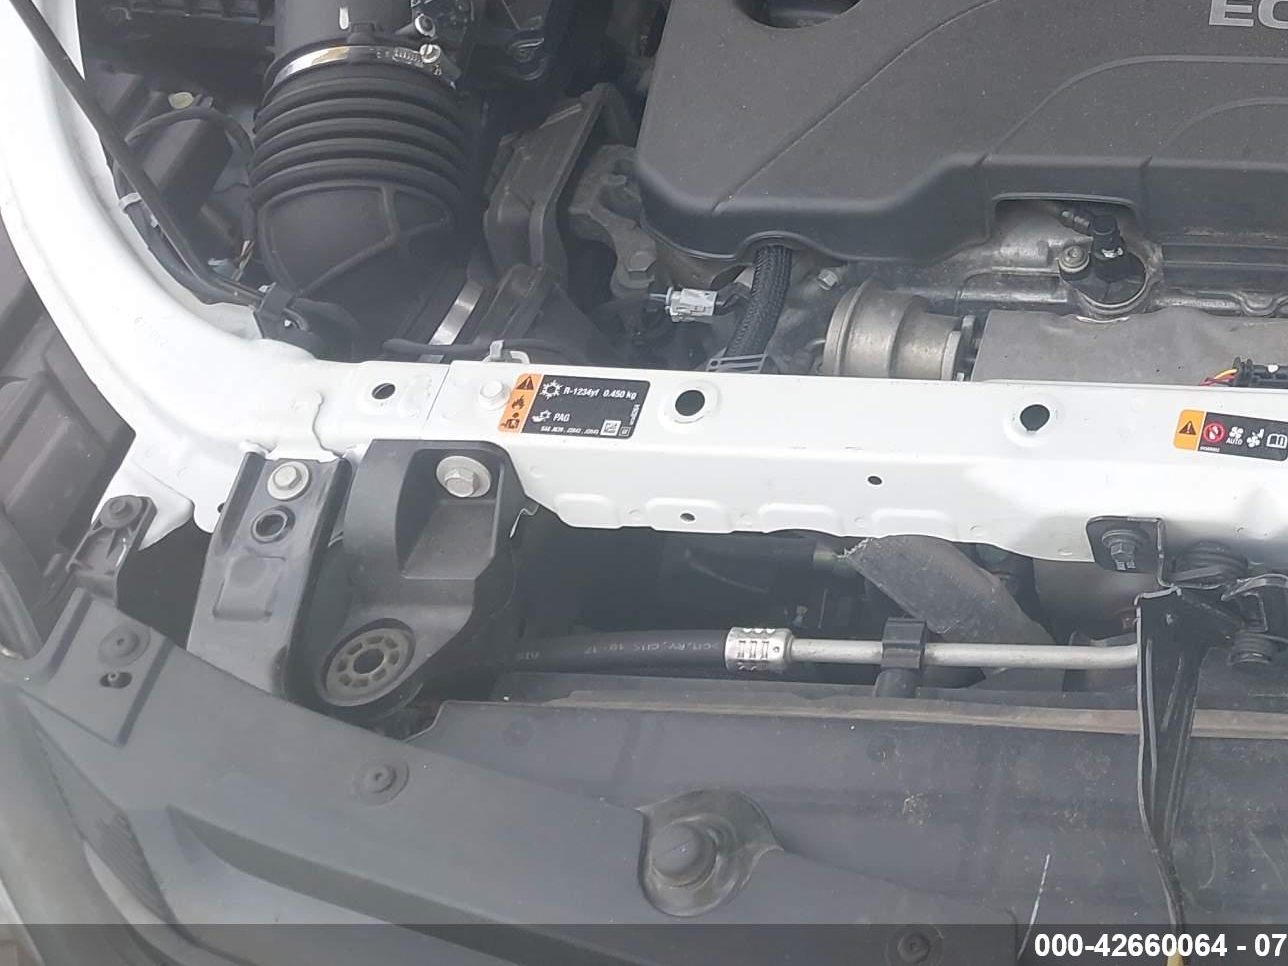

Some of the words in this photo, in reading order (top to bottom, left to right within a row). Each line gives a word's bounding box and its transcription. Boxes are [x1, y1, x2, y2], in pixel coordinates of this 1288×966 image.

[563, 385, 600, 398] R-1234yf
[602, 389, 626, 399] 0.450
[626, 390, 637, 401] kg
[553, 413, 571, 422] PAG
[1226, 437, 1243, 445] AUTO
